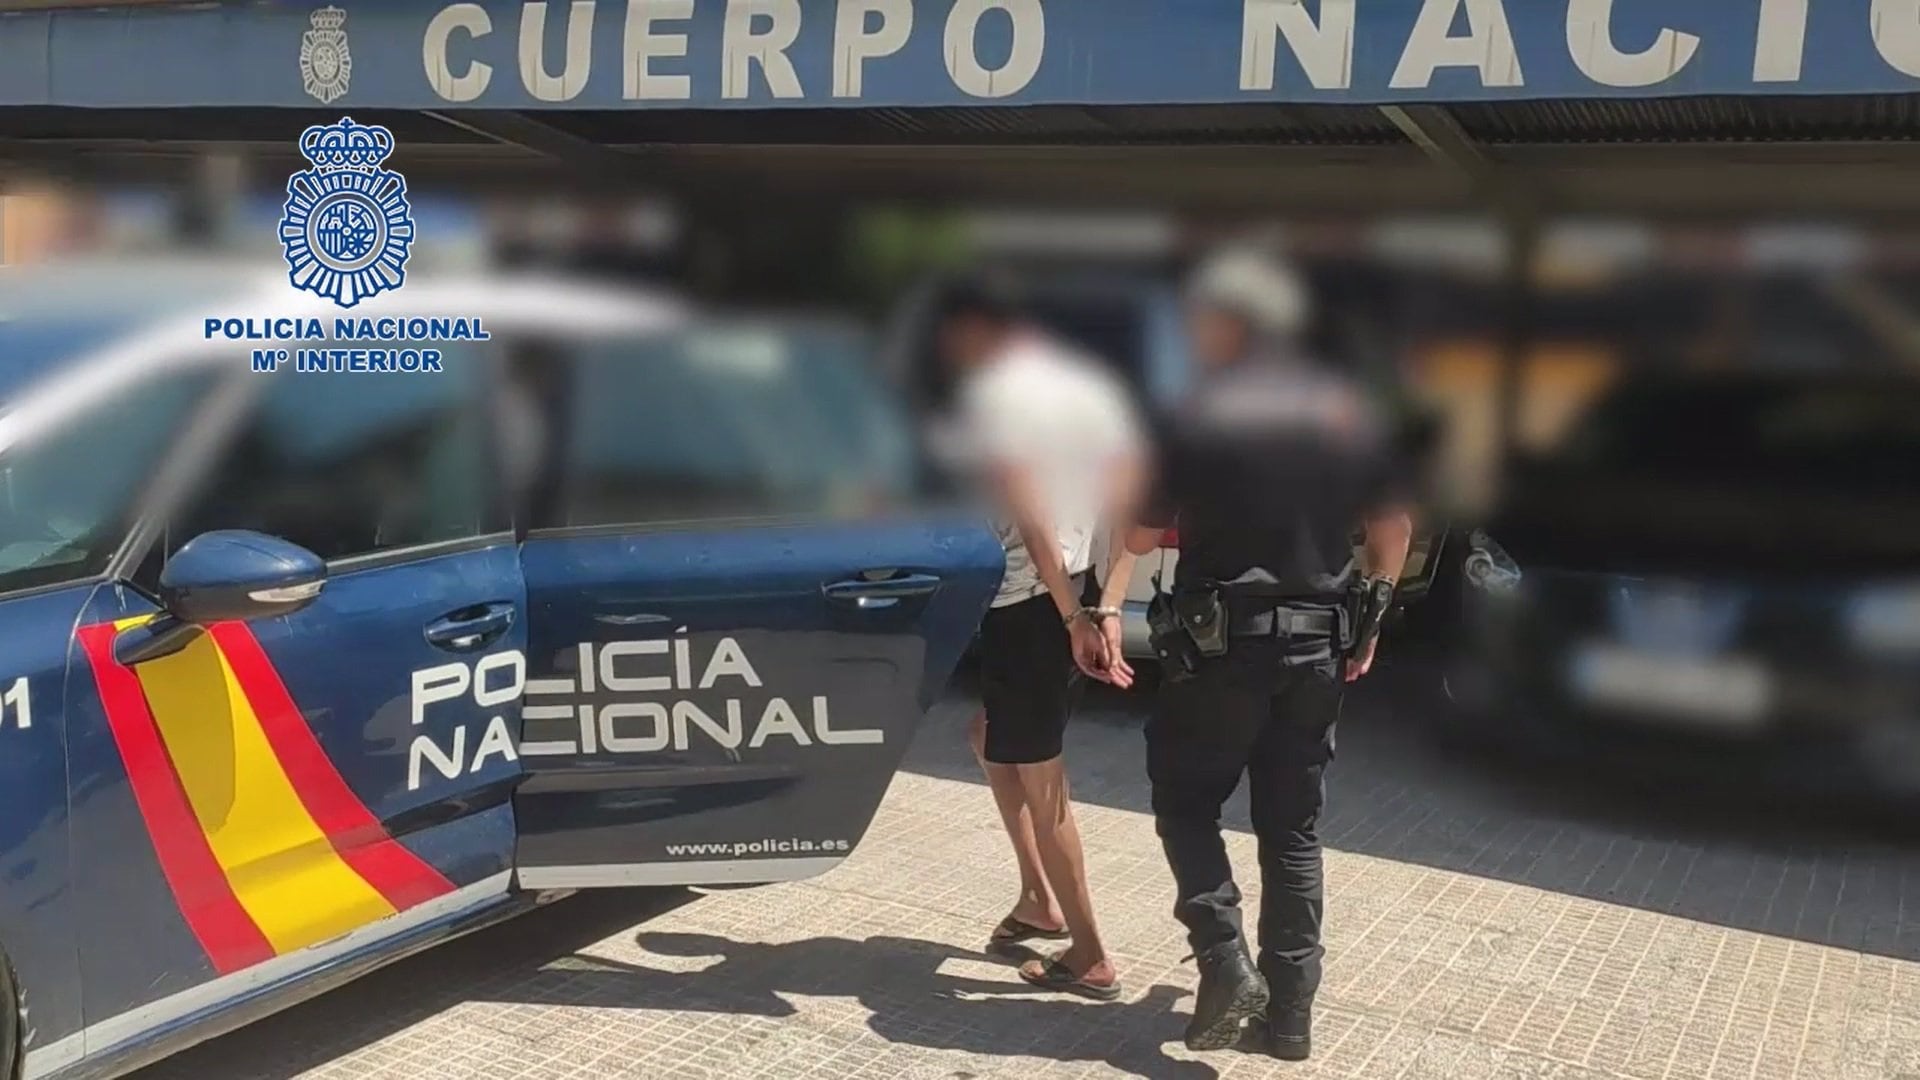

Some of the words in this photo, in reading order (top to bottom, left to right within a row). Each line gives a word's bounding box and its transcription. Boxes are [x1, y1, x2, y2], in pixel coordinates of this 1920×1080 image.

[422, 0, 1046, 102] CUERPO
[0, 676, 31, 729] 1
[408, 696, 884, 791] NACIONAL
[665, 837, 850, 857] www.policia.es
